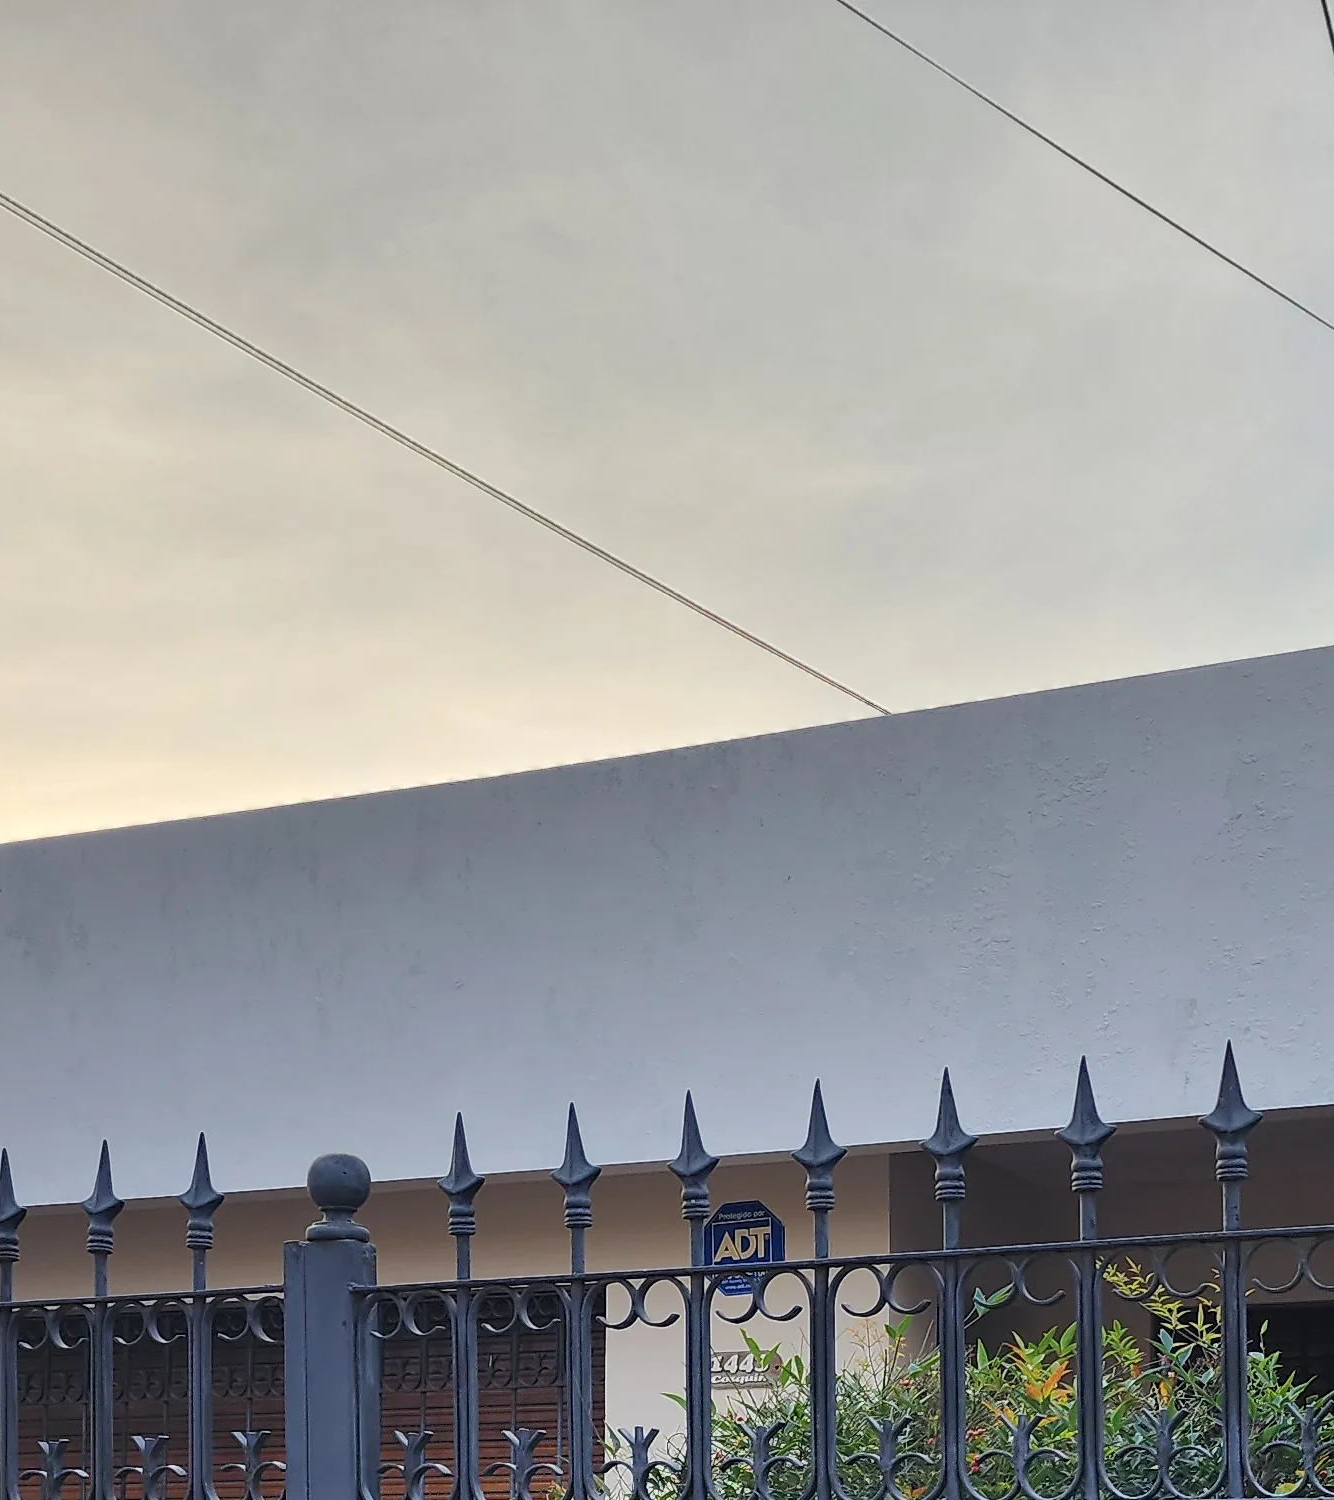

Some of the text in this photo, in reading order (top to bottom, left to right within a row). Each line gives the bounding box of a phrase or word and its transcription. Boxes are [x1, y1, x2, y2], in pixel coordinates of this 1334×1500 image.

[718, 1210, 766, 1220] Protegido por
[714, 1226, 771, 1262] ADT
